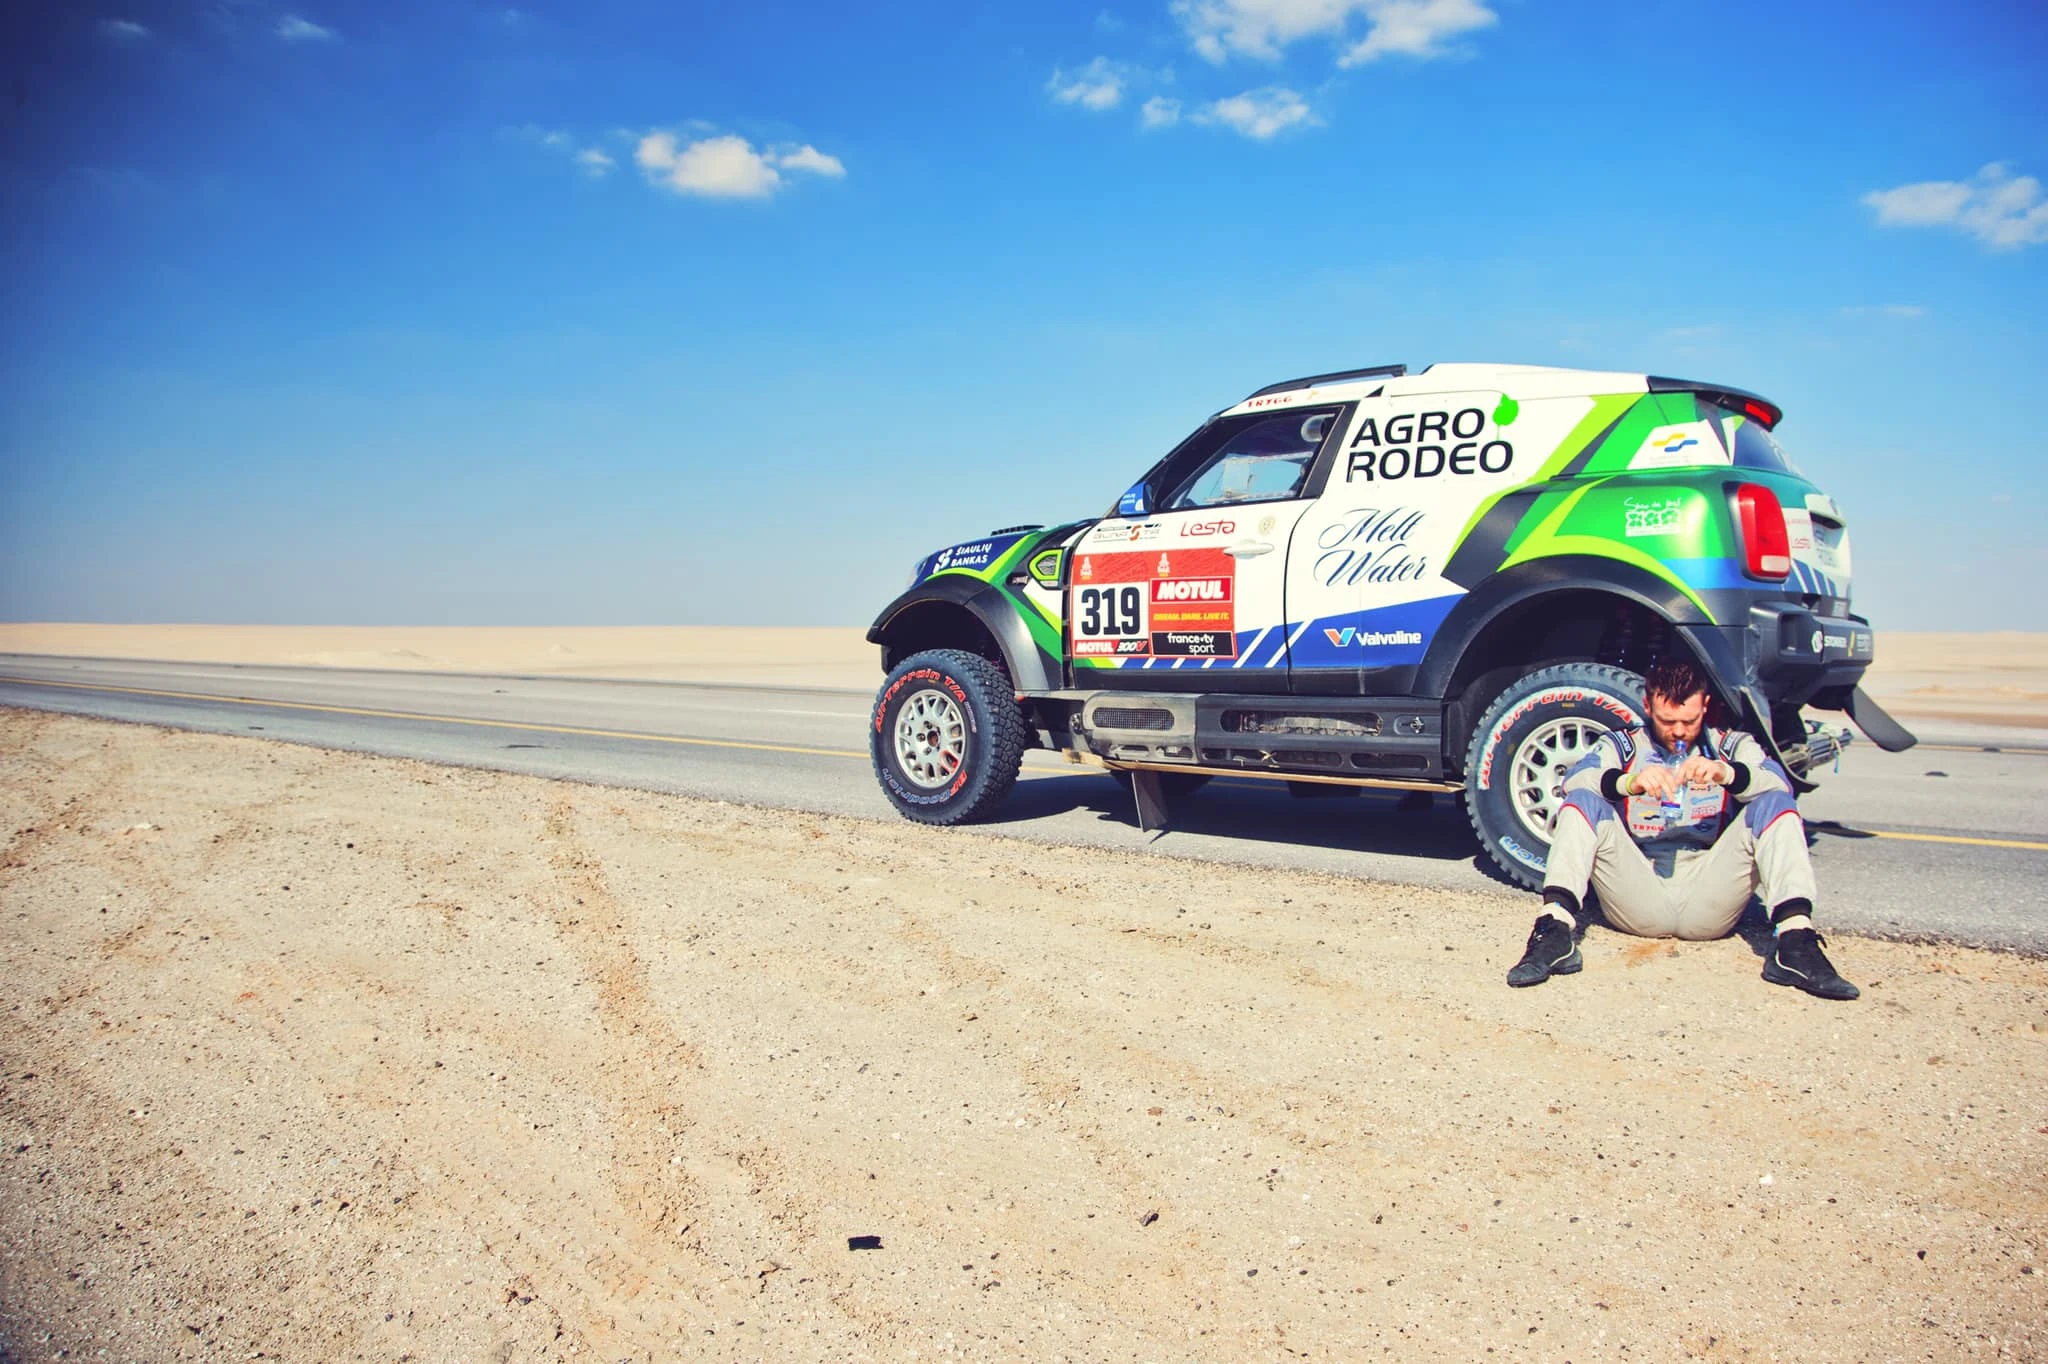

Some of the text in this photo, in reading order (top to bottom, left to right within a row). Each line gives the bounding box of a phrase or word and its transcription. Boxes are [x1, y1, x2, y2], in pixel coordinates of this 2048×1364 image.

[1350, 408, 1485, 448] AGRO
[1346, 440, 1514, 483] RODEO
[1180, 520, 1236, 537] Lesta
[1318, 506, 1426, 549] Melt
[951, 554, 988, 567] BANKAS
[1313, 544, 1427, 587] Water
[1157, 580, 1225, 601] MOTUL
[1081, 586, 1141, 636] 319
[1075, 640, 1148, 653] MOTUL 300V
[1355, 631, 1422, 646] Valvoline
[1188, 643, 1215, 656] sport
